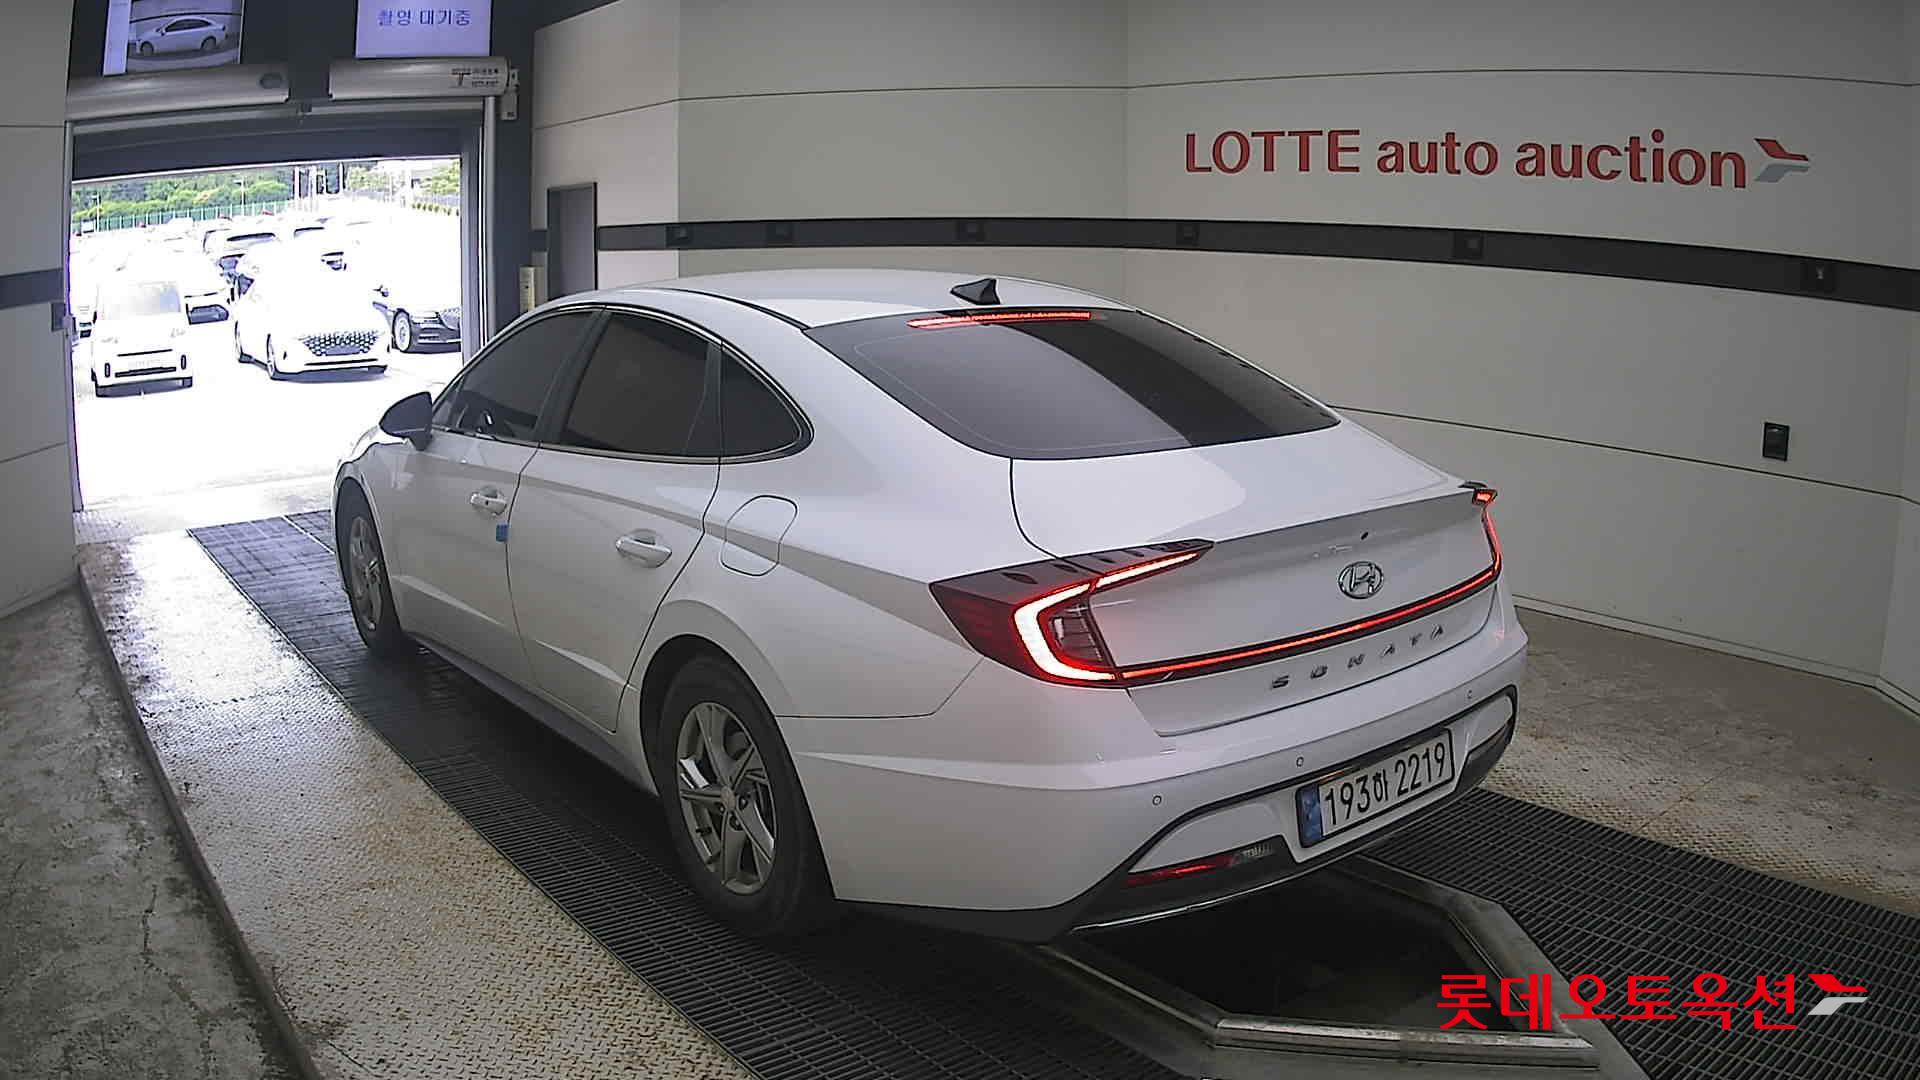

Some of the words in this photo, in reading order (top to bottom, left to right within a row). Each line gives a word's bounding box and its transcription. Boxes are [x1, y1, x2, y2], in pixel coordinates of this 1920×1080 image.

[420, 9, 471, 26] 대기중
[1185, 129, 1361, 174] LOTTE
[1376, 131, 1499, 176] auto
[1515, 128, 1746, 189] auction
[1270, 624, 1444, 690] SONATA
[1325, 768, 1388, 826] 193하
[1395, 742, 1446, 797] 2219
